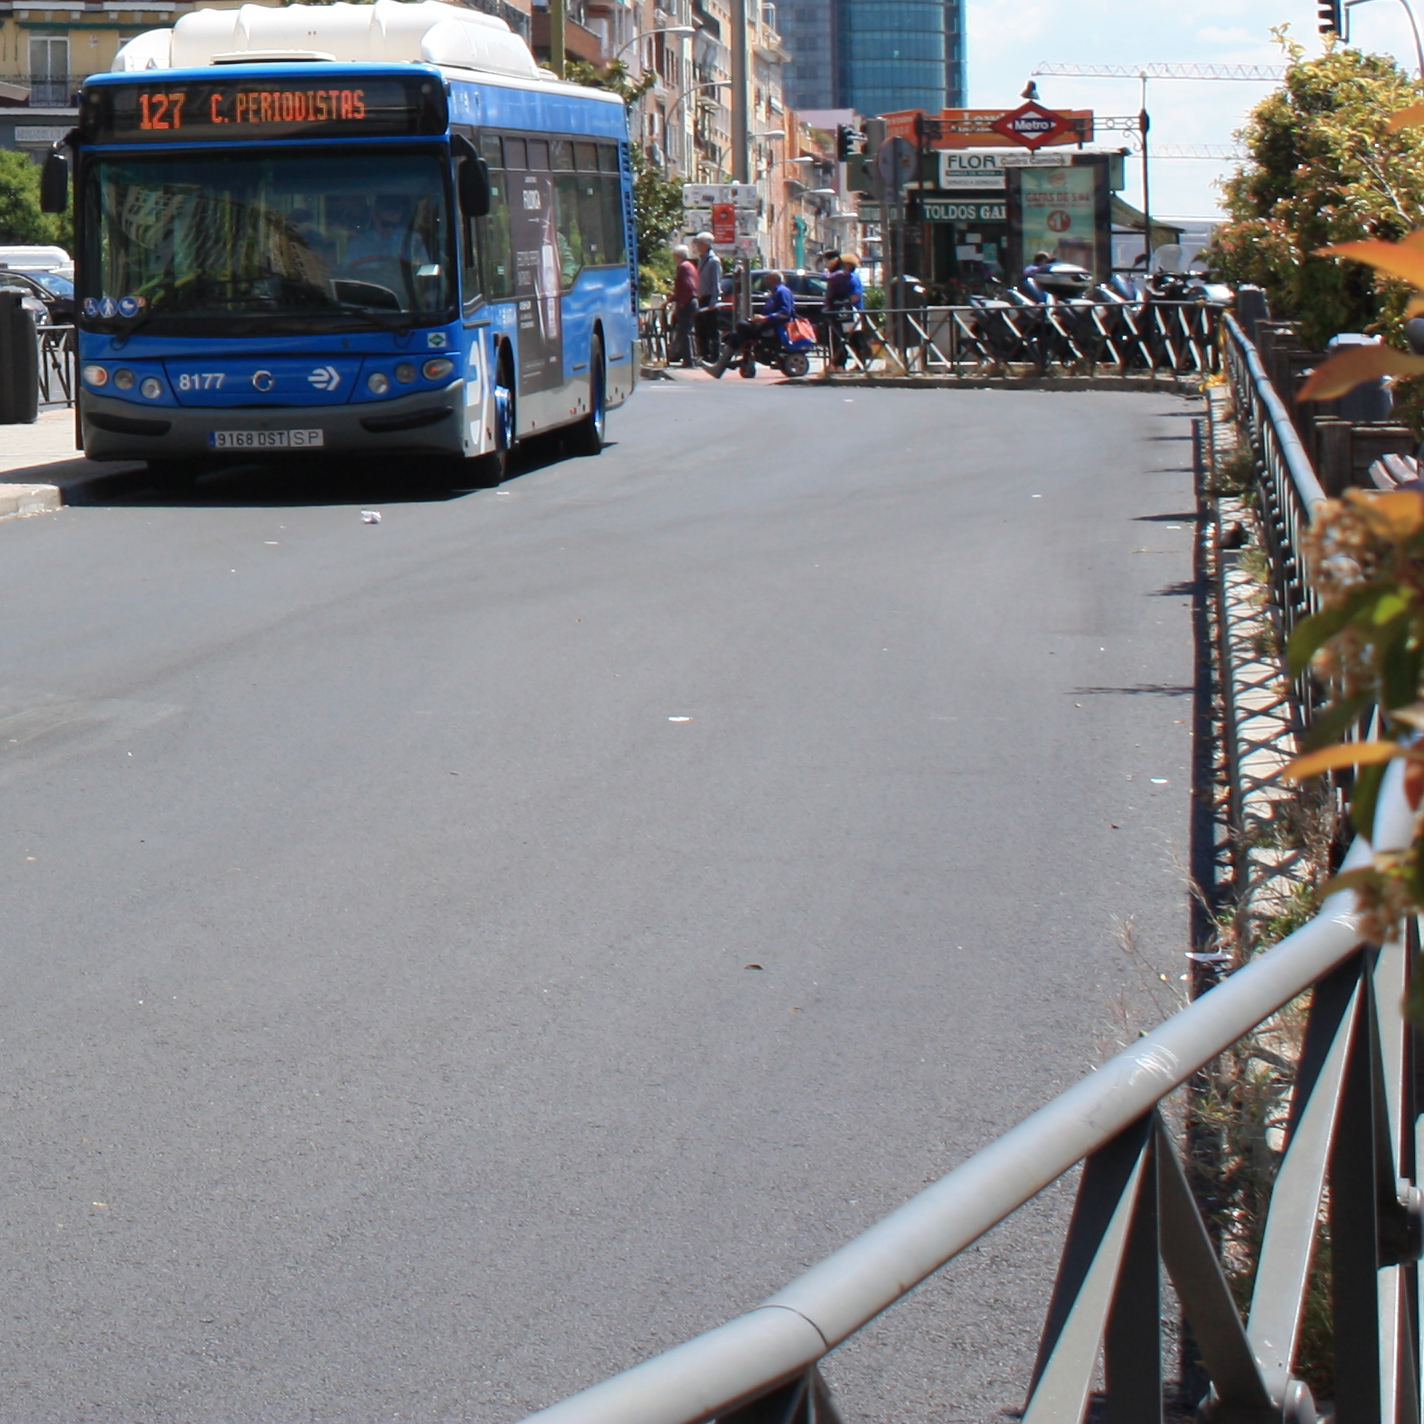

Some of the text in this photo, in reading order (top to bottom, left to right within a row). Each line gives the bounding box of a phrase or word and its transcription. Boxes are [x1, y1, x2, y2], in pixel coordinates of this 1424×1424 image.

[138, 89, 366, 130] 127 C. PERIODISTAS
[1014, 119, 1050, 131] Metro
[948, 155, 996, 169] FLOR
[923, 205, 977, 220] TOLDOS
[179, 373, 226, 390] 8177
[217, 432, 253, 446] 9168
